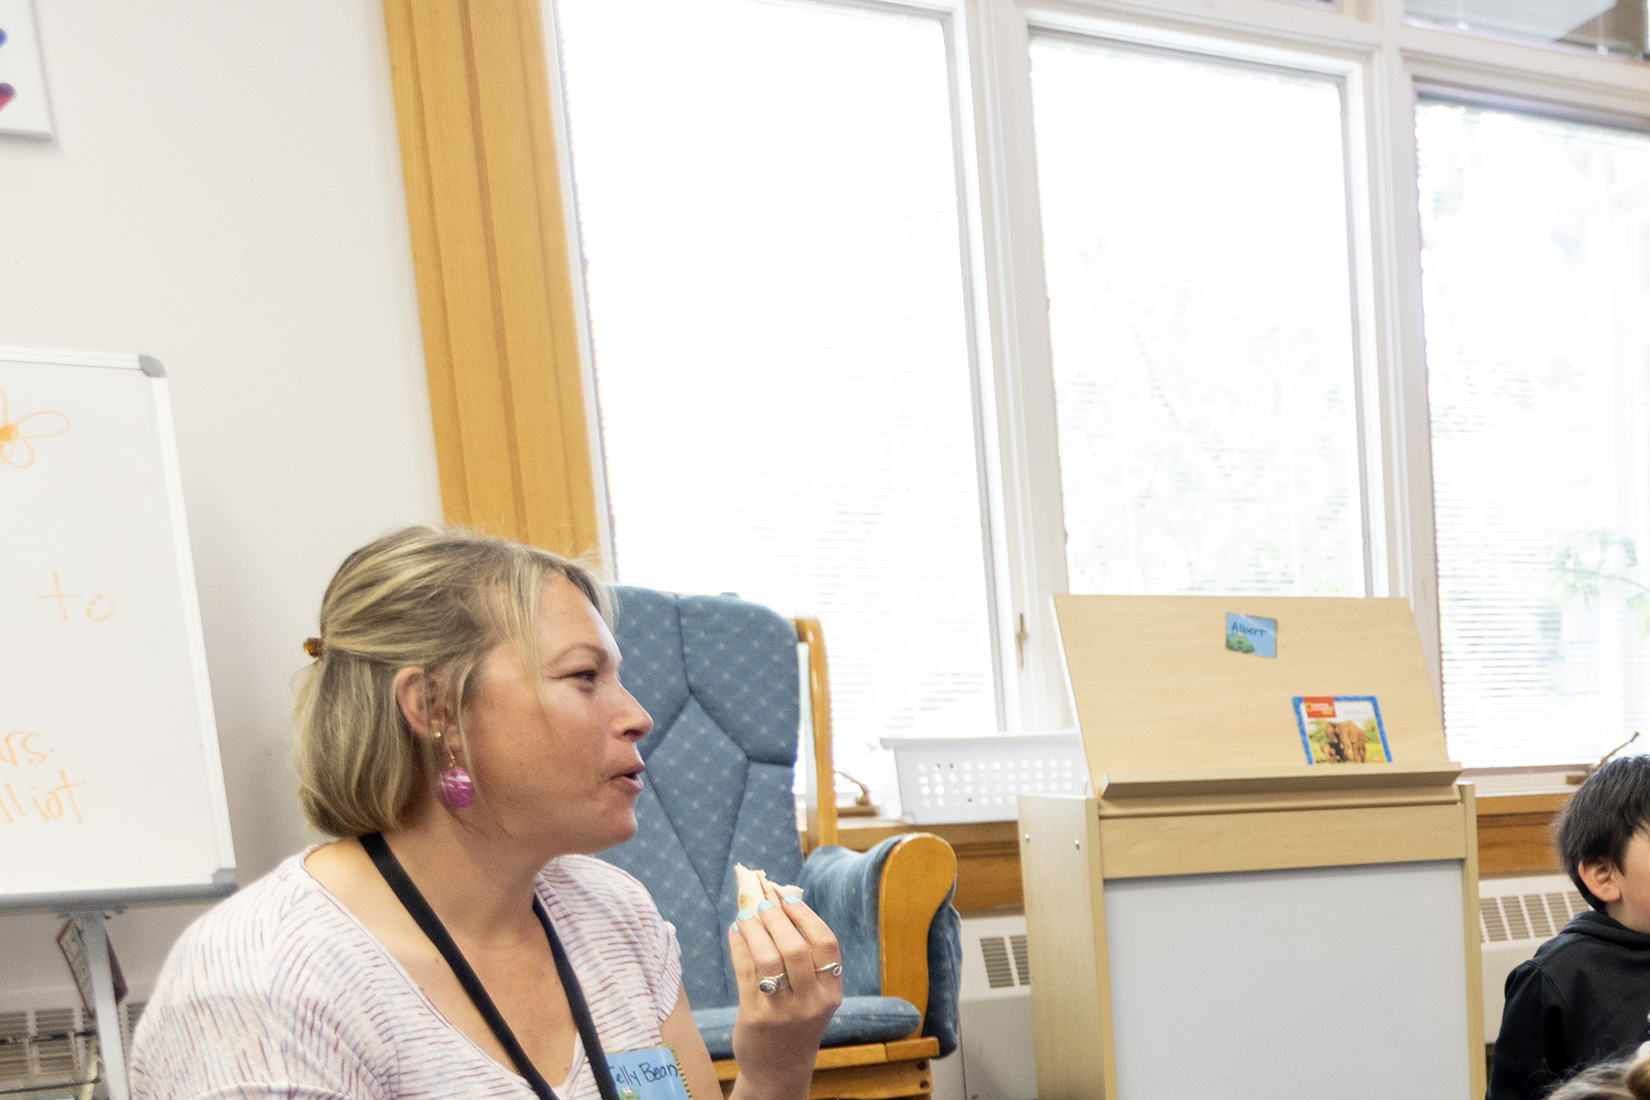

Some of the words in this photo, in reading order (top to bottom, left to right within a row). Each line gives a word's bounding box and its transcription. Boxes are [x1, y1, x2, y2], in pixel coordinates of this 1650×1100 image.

[37, 572, 117, 622] to
[609, 1064, 642, 1087] elly
[638, 1062, 679, 1083] Bean
